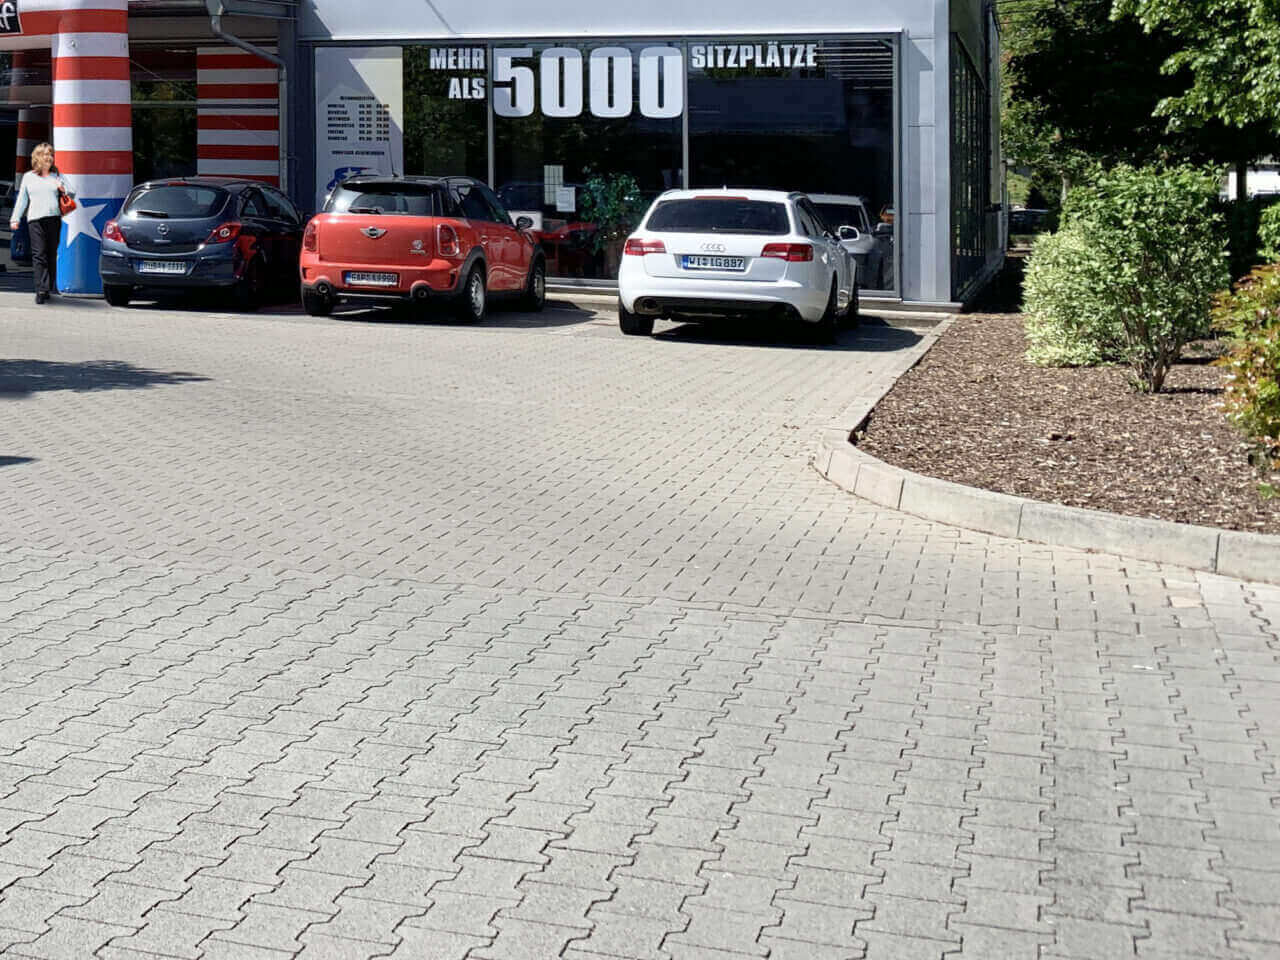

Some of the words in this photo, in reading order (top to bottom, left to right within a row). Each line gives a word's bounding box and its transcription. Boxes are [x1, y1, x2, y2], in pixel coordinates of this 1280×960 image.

[429, 47, 485, 70] MEHR
[691, 42, 819, 69] SITZPLÄTZE
[448, 77, 485, 99] ALS
[492, 47, 684, 118] 5000
